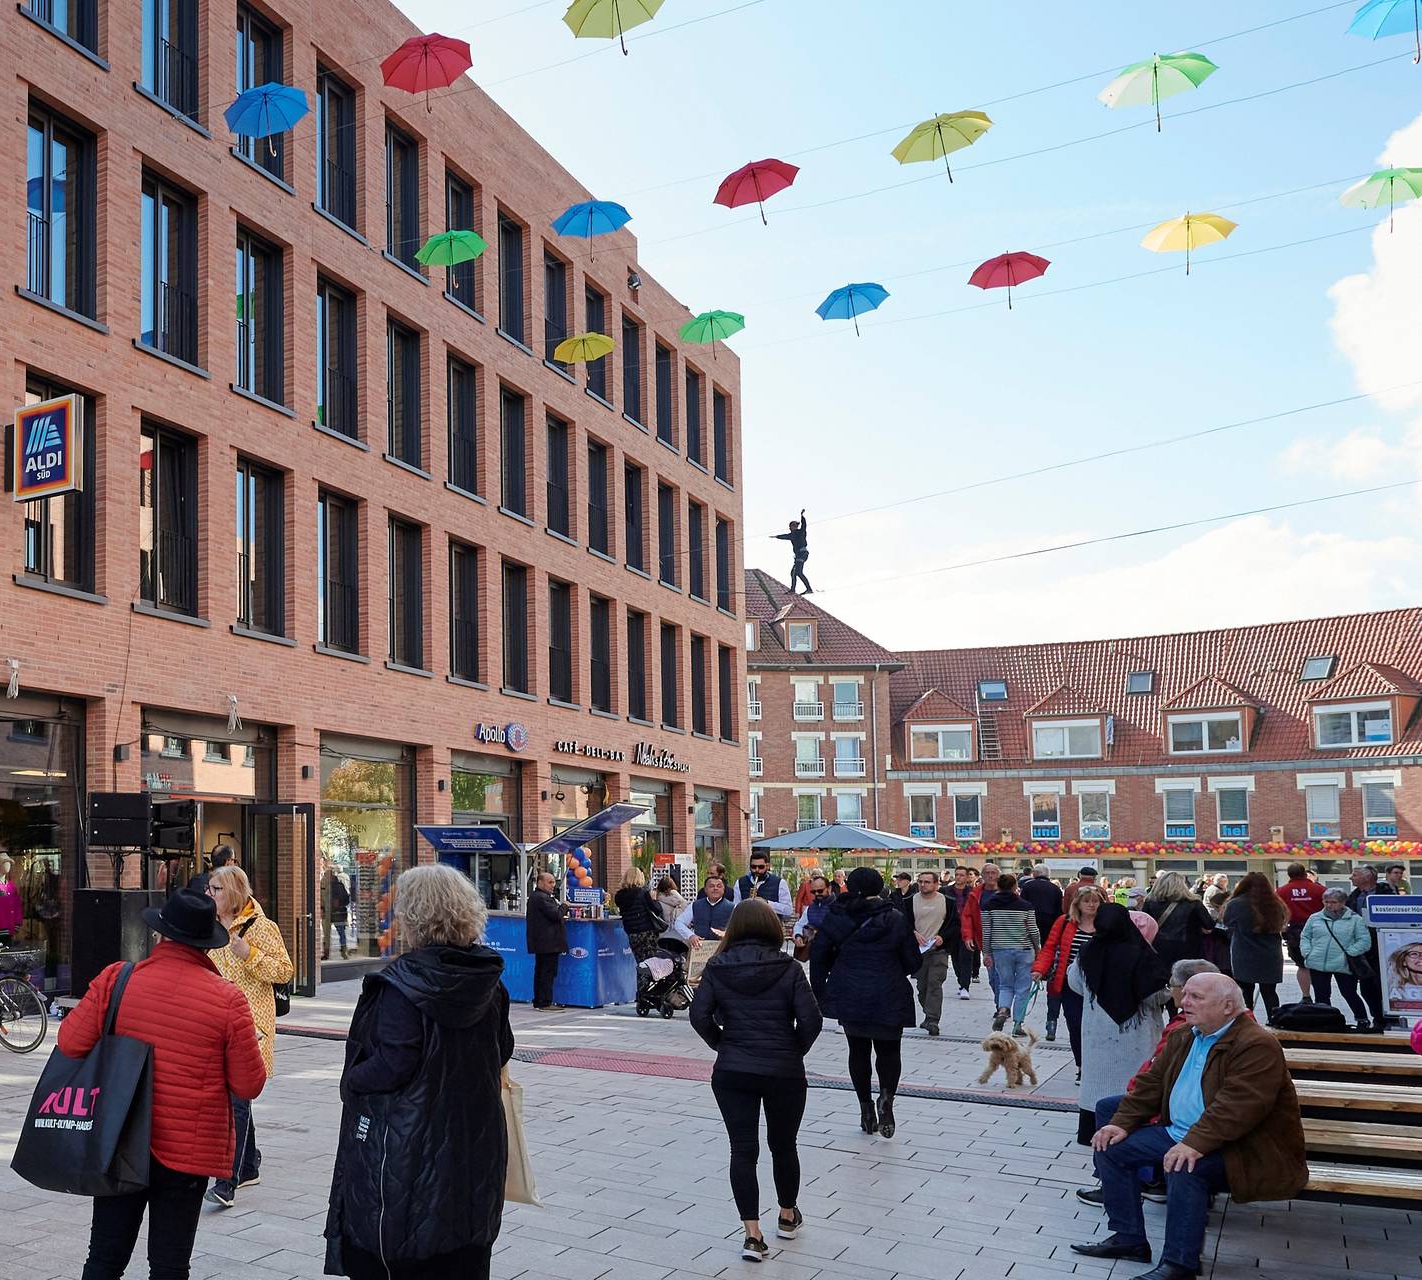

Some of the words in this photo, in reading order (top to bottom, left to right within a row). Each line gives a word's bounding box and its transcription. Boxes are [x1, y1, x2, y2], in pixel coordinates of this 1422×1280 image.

[25, 450, 63, 473] ALDI
[36, 469, 51, 480] SÜD
[478, 723, 506, 744] Apollo
[1033, 826, 1059, 838] und
[1167, 824, 1195, 837] und
[1222, 824, 1246, 836] hei
[1368, 823, 1398, 836] Zen
